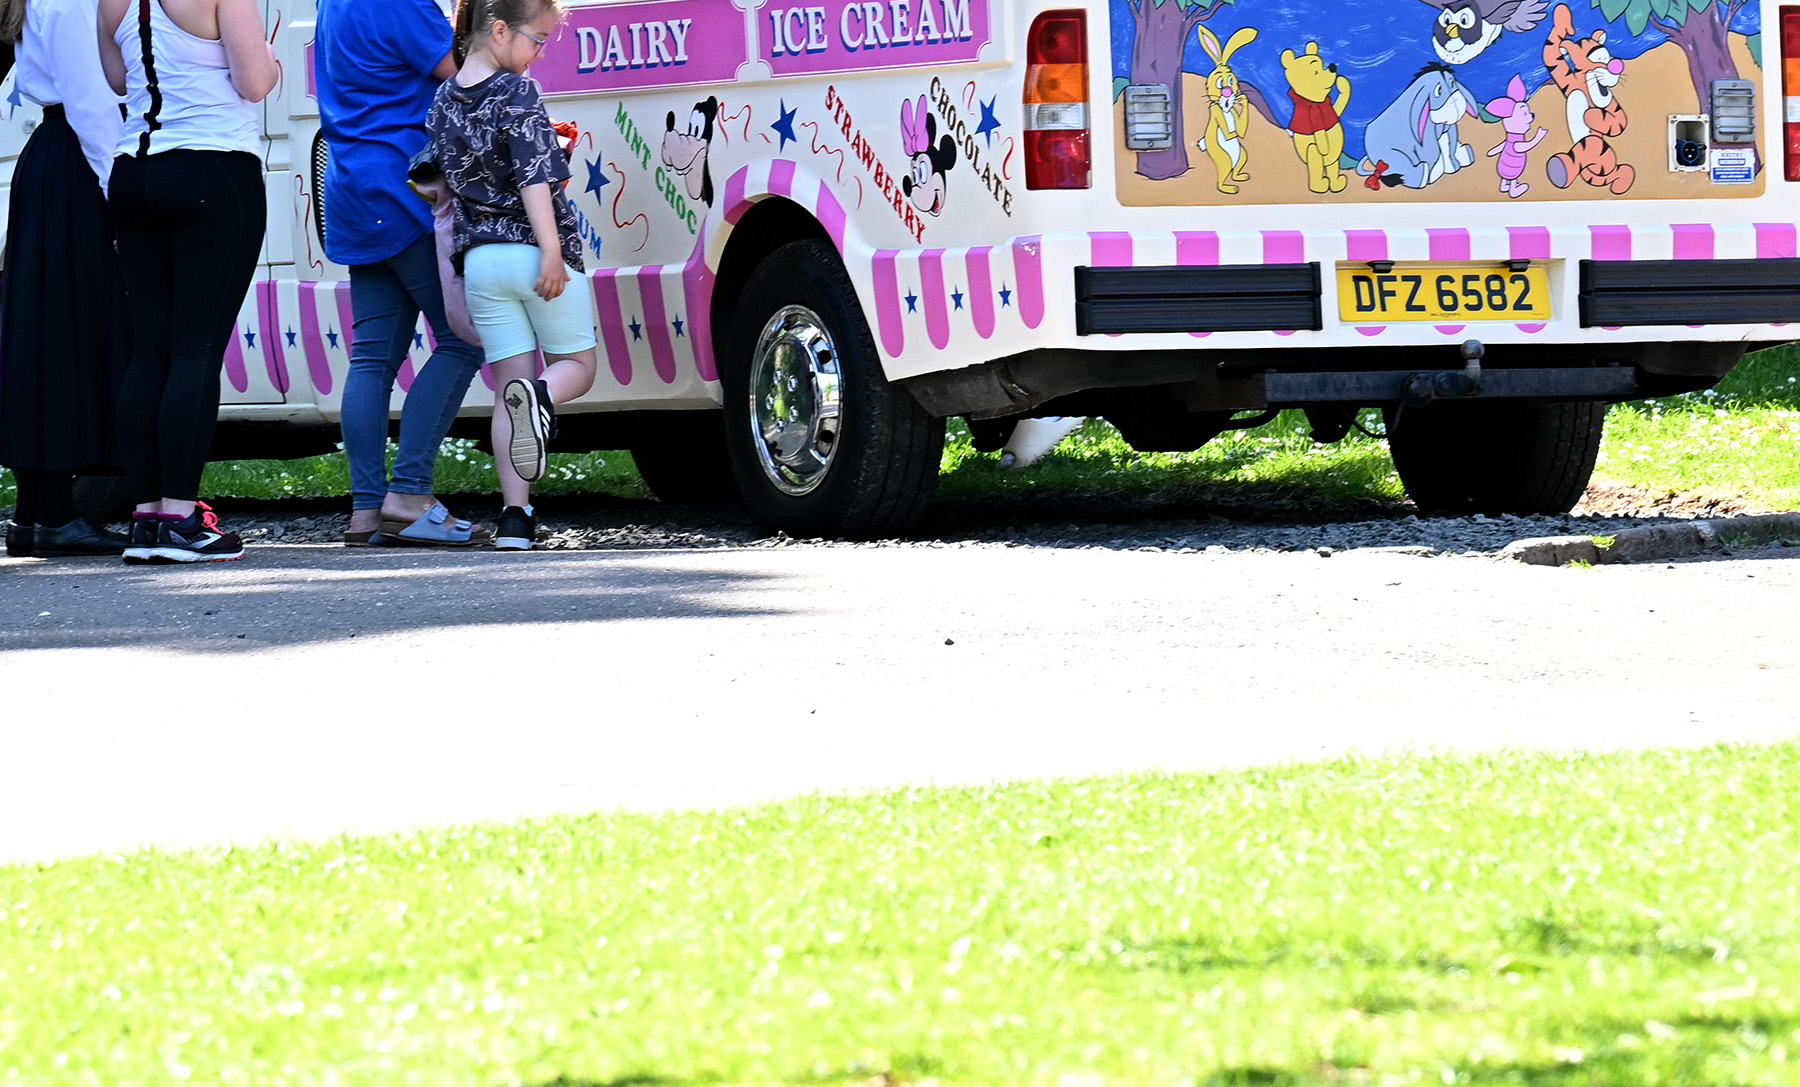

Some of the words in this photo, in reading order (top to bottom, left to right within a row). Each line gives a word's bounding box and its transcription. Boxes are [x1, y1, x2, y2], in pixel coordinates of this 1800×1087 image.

[577, 18, 692, 74] DAIRY
[770, 6, 828, 57] ICE
[614, 101, 652, 171] MINT
[655, 166, 698, 235] CHOC
[825, 84, 926, 244] STRAWBERRY
[930, 76, 1012, 218] CHOCOLATE
[1352, 275, 1426, 312] DFZ
[1436, 274, 1533, 311] 6582
